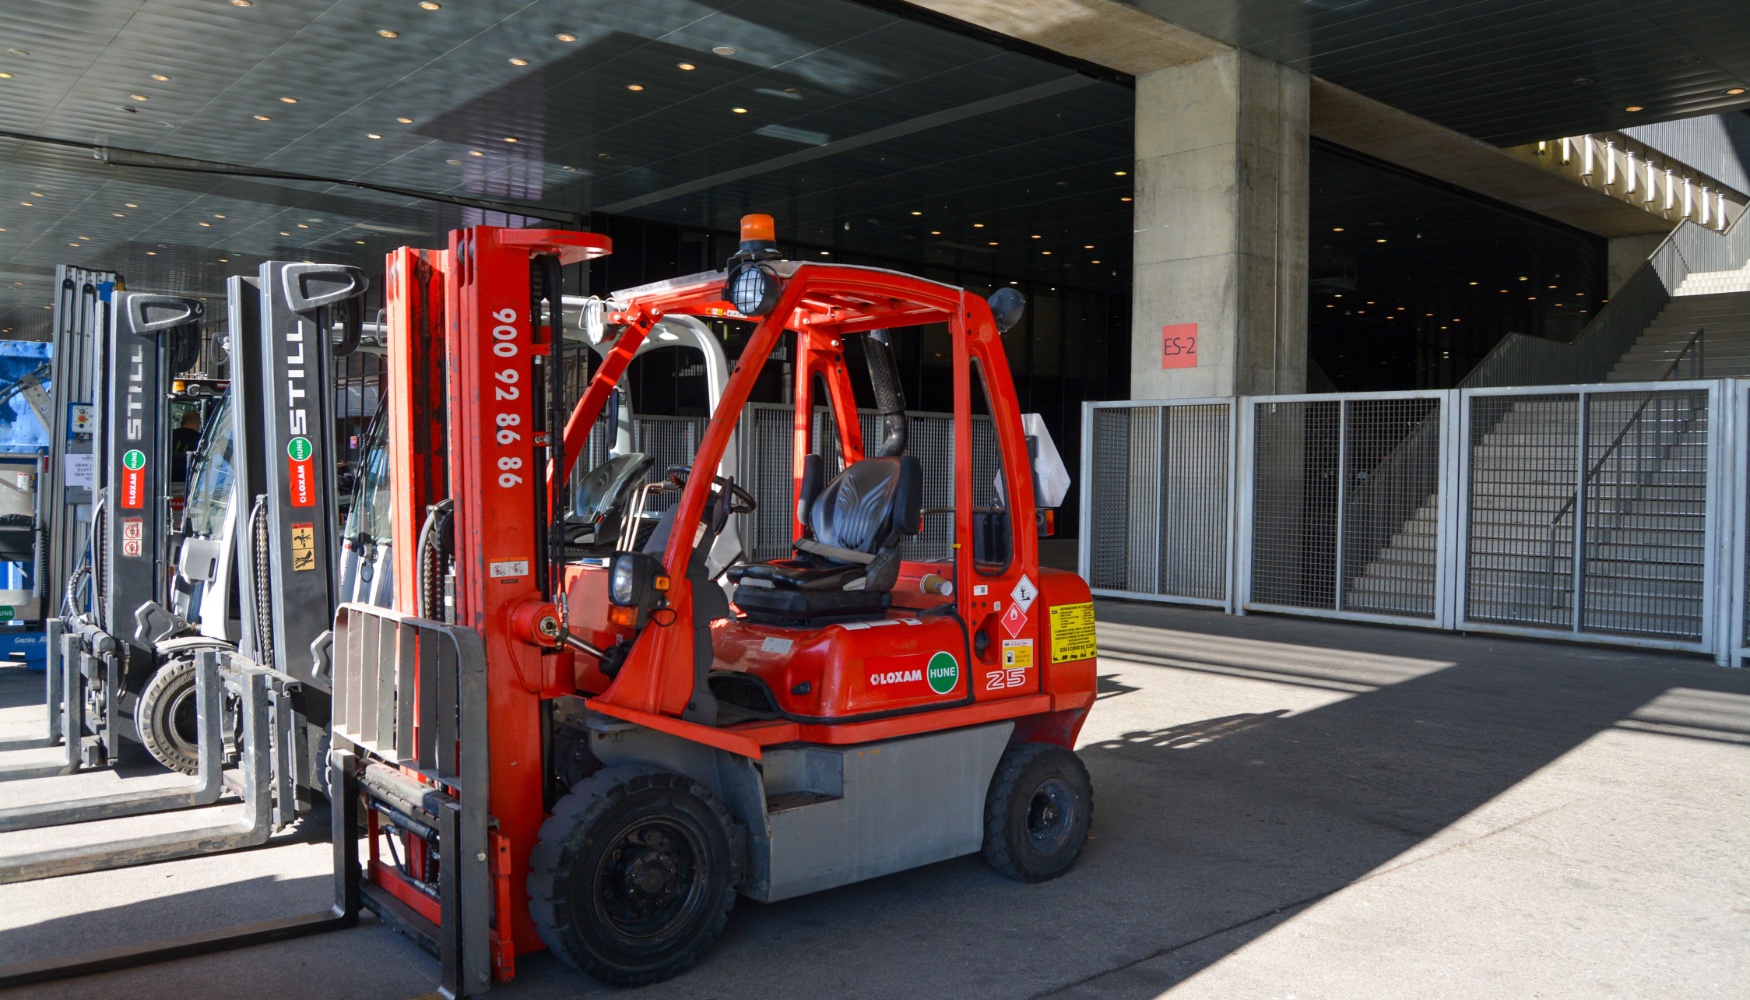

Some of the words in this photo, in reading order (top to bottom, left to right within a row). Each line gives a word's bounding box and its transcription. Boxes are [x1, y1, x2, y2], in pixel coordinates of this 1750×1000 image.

[492, 308, 518, 358] 900
[1164, 336, 1196, 356] ES-2
[126, 344, 143, 440] STILL
[286, 320, 307, 435] STILL
[494, 368, 520, 401] 92
[496, 413, 521, 445] 86
[296, 439, 304, 460] HUNE
[129, 473, 137, 500] LOXAM
[297, 465, 307, 499] LOXAM
[497, 457, 523, 488] 86
[880, 669, 923, 685] LOXAM
[929, 666, 956, 679] HUNE
[986, 667, 1026, 691] 25
